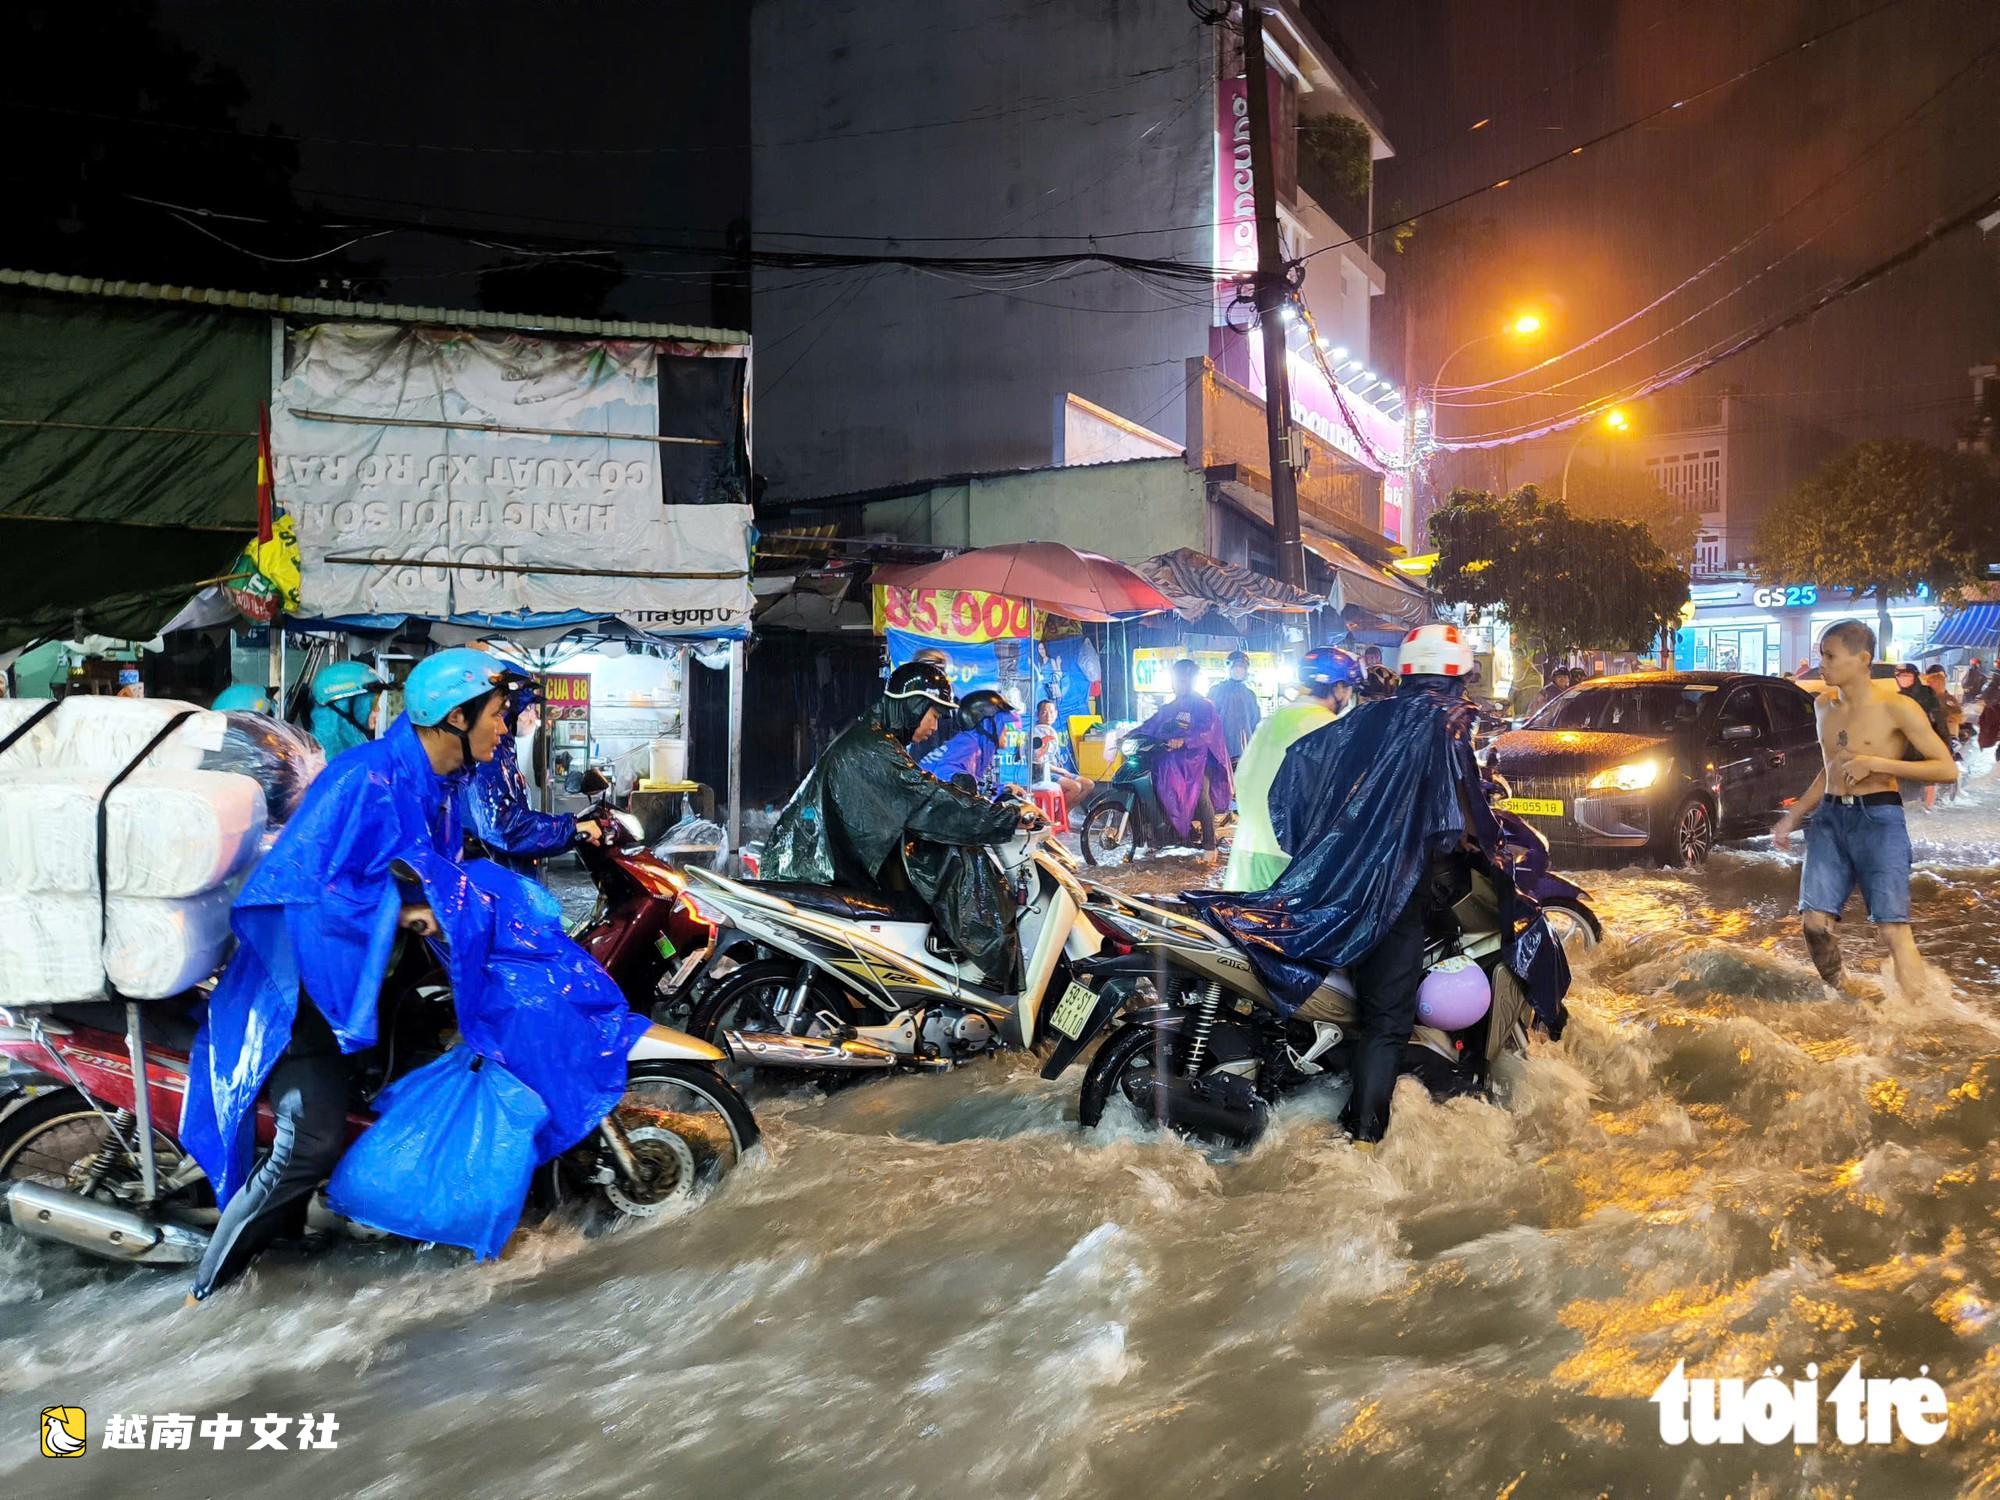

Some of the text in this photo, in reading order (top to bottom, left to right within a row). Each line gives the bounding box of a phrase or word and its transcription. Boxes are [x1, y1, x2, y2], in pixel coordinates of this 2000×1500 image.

[356, 453, 413, 489] RÕ
[419, 454, 479, 490] XỨ
[485, 457, 594, 496] XUẤT
[599, 459, 651, 494] CÓ
[370, 545, 521, 592] 100%
[1753, 585, 1817, 608] GS25
[545, 678, 588, 700] CUA 88
[882, 971, 922, 984] 125
